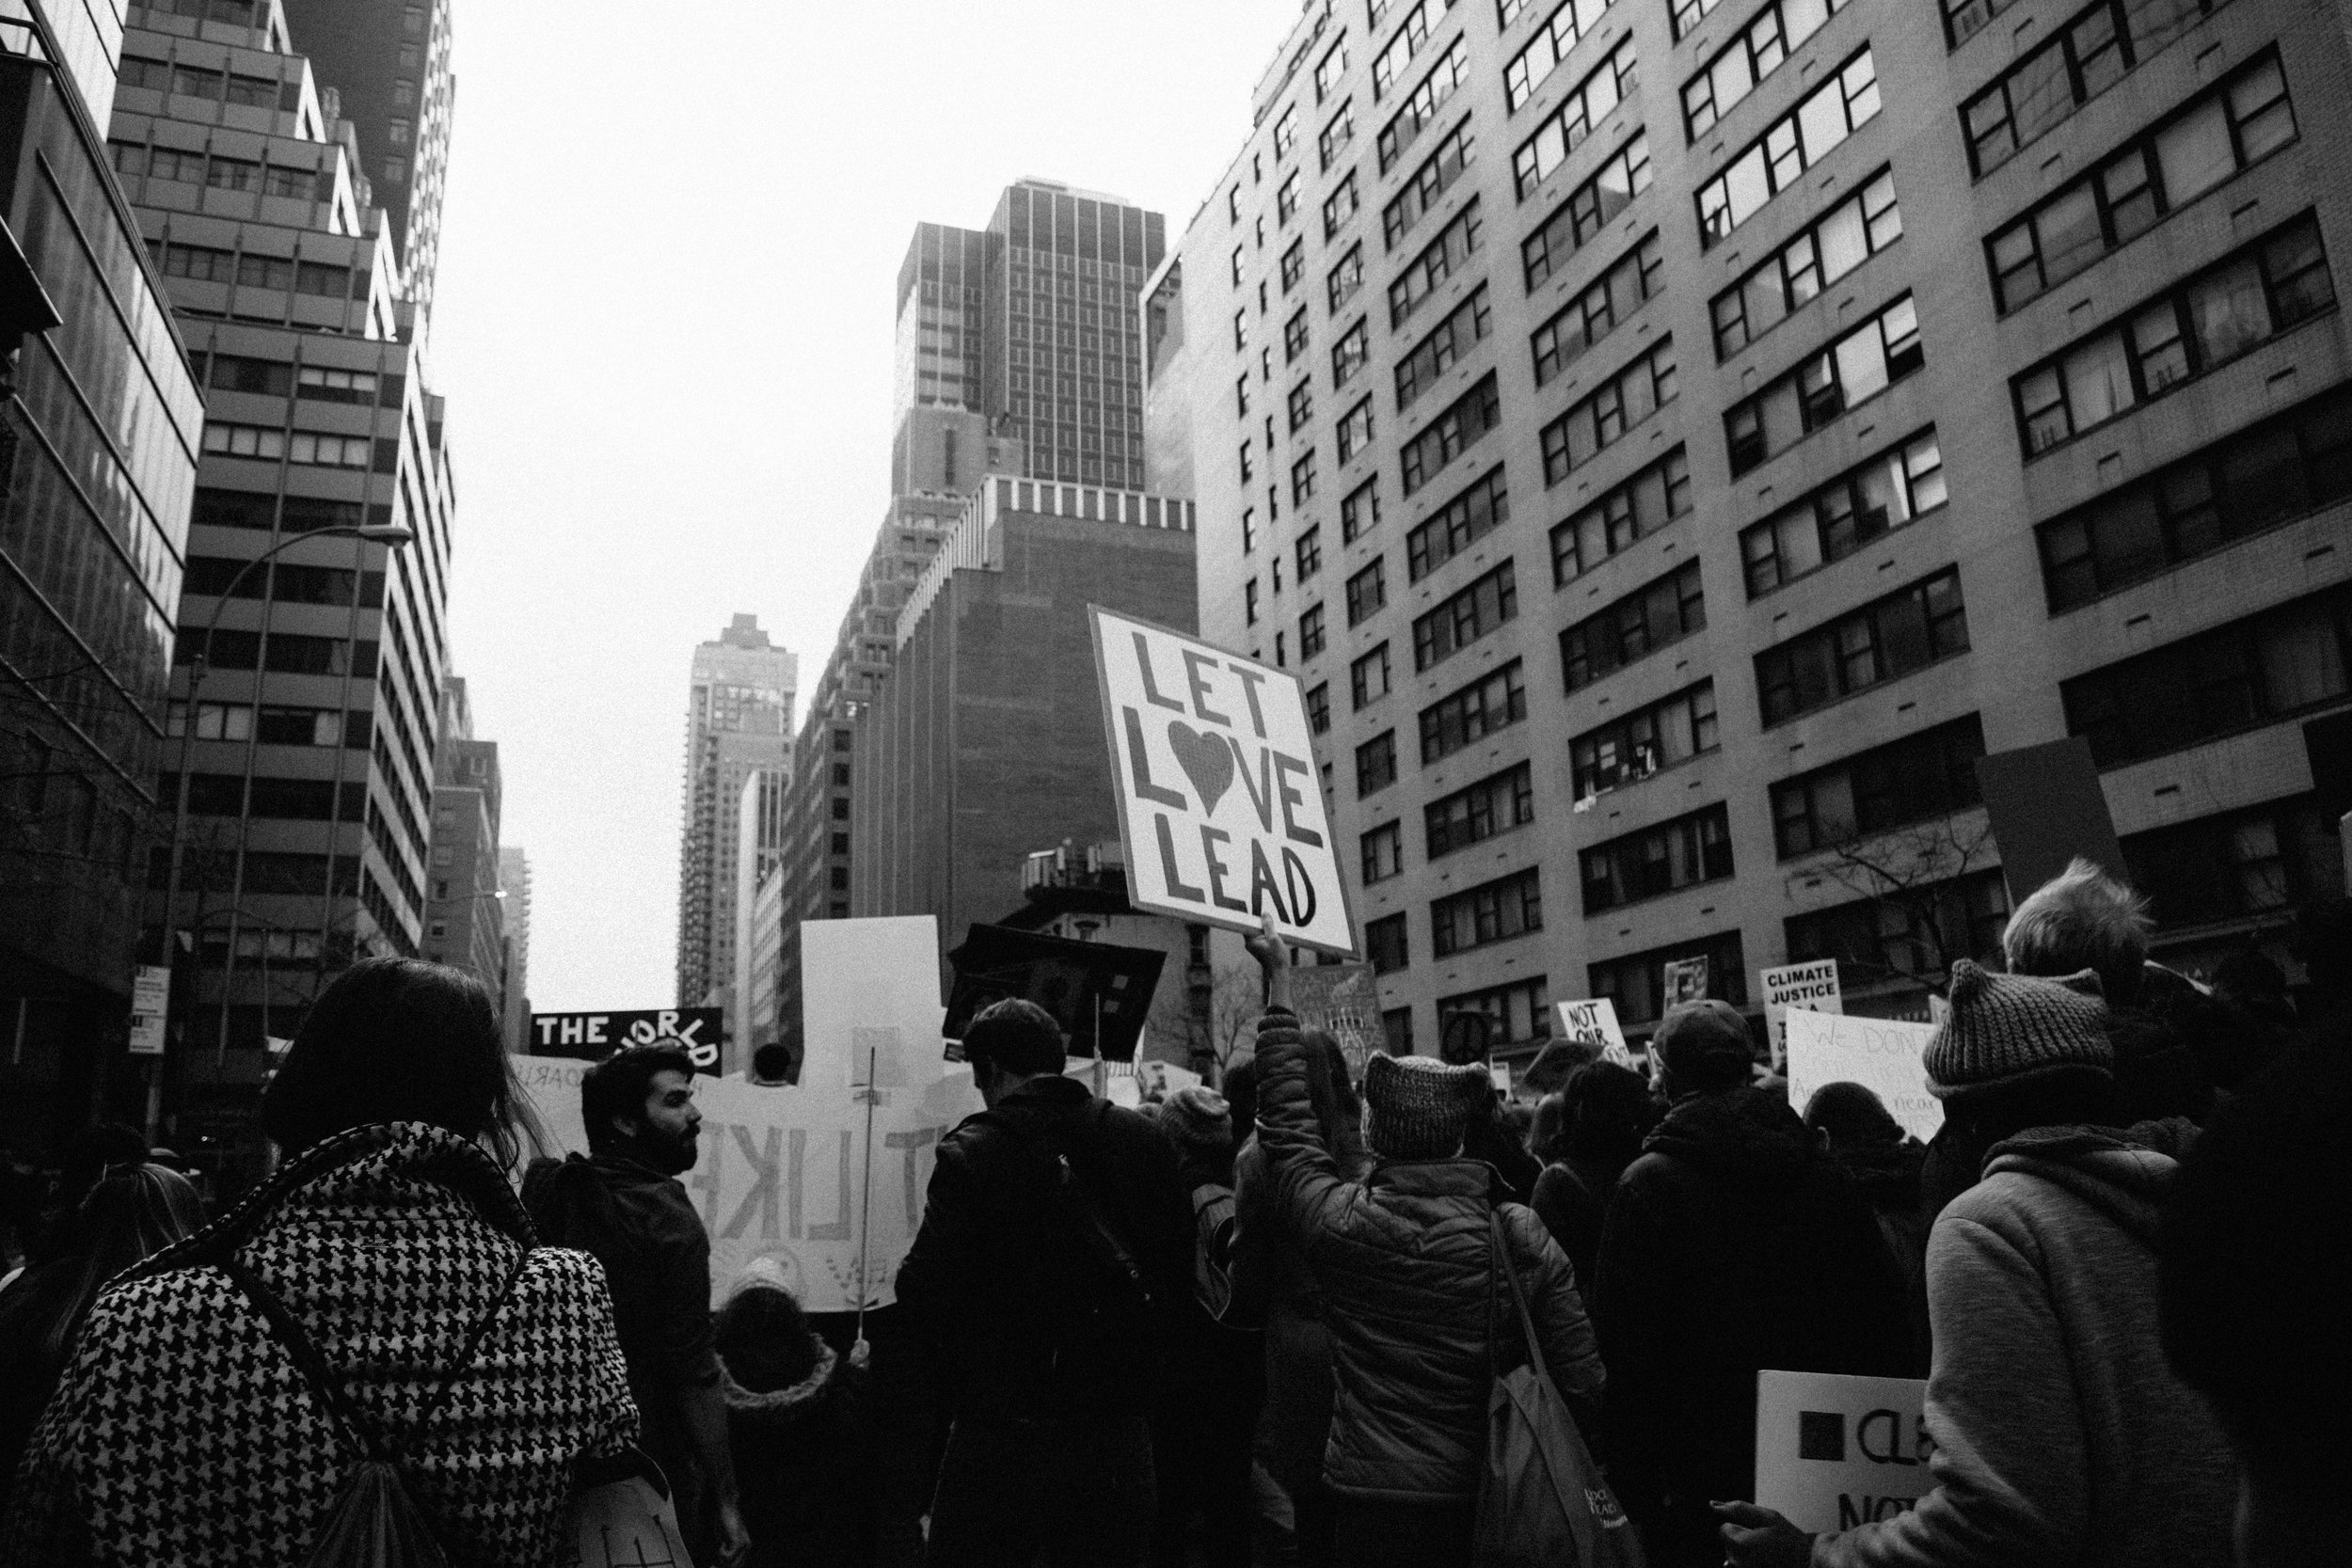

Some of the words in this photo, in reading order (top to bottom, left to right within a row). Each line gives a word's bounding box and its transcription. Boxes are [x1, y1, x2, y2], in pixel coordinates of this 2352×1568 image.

[1131, 631, 1266, 739] LET
[1154, 813, 1316, 927] LEAD
[1767, 965, 1834, 988] CLIMATE
[1771, 982, 1836, 1006] JUSTICE
[1567, 1003, 1597, 1028] NOT
[535, 1016, 609, 1045] THE
[613, 1010, 719, 1068] ORLD
[1575, 1027, 1609, 1045] OUR
